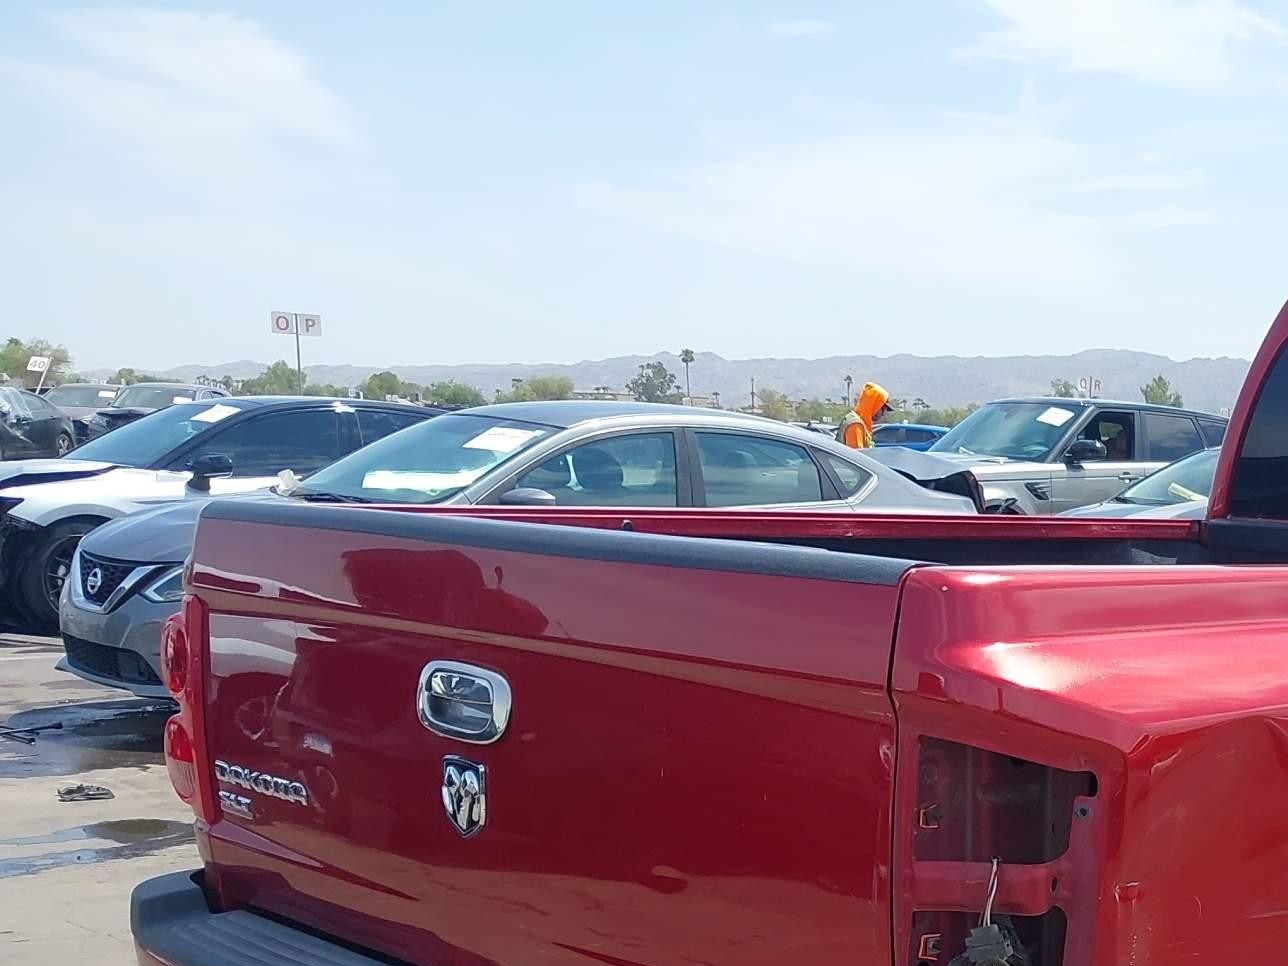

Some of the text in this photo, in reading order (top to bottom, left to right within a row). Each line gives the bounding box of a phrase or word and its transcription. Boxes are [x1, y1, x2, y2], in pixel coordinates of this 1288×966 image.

[276, 315, 290, 331] O
[305, 318, 316, 333] P
[30, 359, 45, 369] 40
[1094, 379, 1102, 391] R
[214, 759, 309, 807] DAKOTA
[218, 790, 252, 815] SLT
